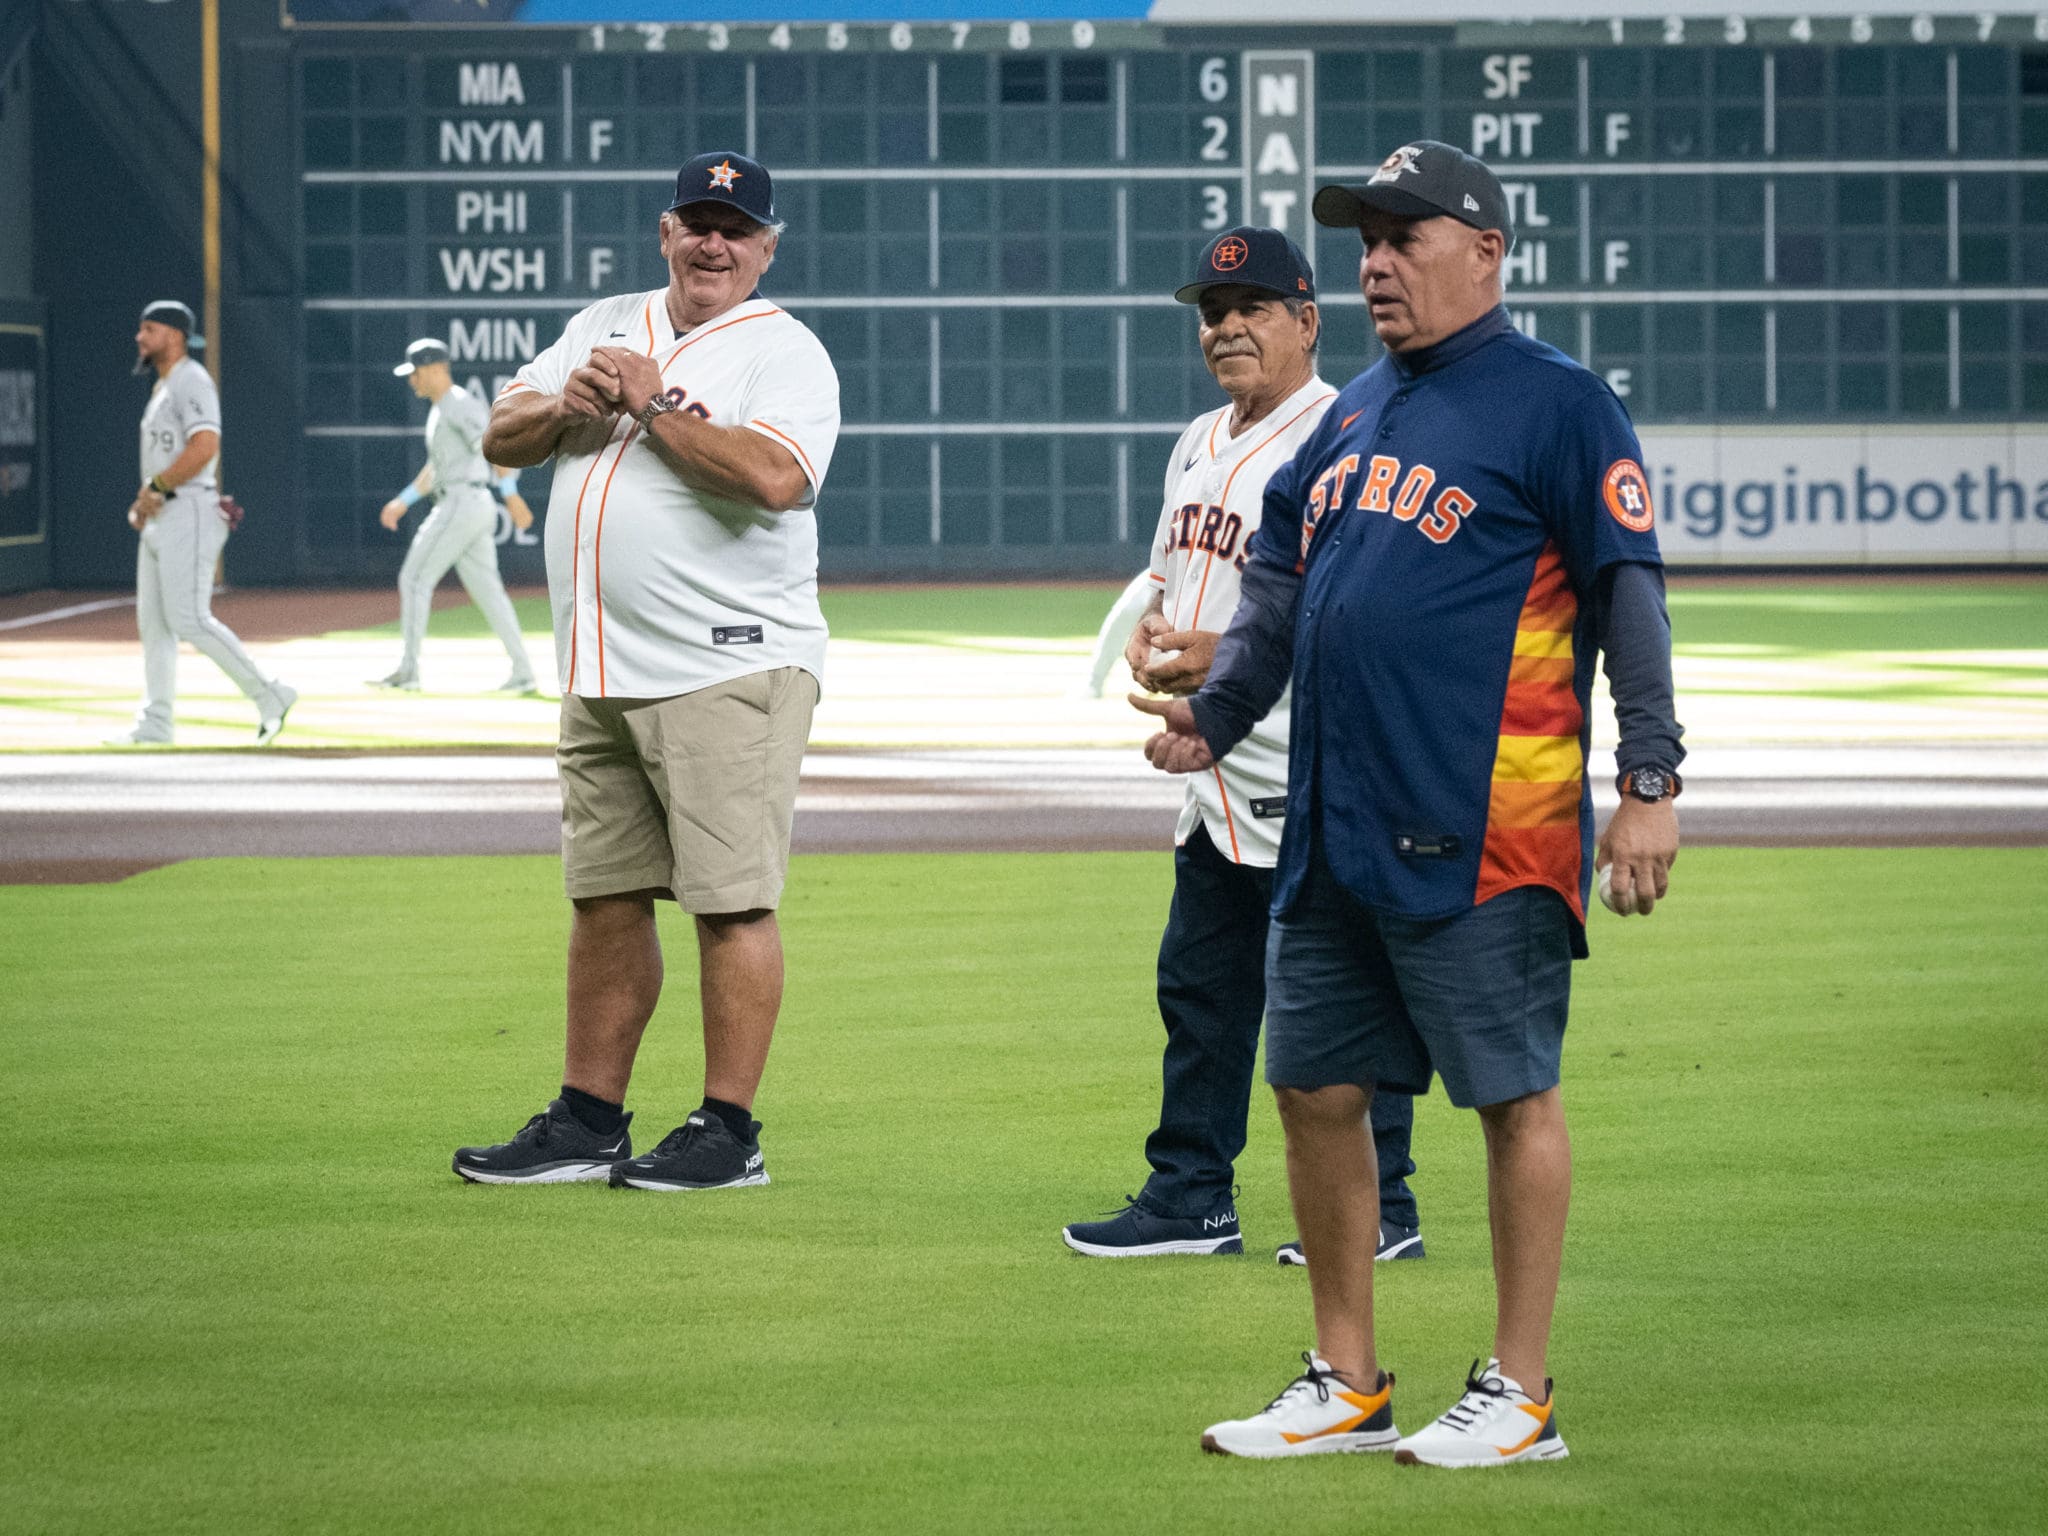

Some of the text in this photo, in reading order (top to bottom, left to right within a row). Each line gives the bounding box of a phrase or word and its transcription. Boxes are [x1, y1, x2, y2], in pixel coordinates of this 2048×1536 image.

[591, 21, 1096, 51] 1 2 3 4 5 6 7 8 9
[1608, 15, 1624, 43] 1
[1664, 15, 1685, 43] 2
[1725, 15, 1747, 43] 3
[1789, 14, 1813, 43] 4
[1851, 14, 1873, 43] 5
[1911, 13, 1935, 42] 6
[1976, 13, 1997, 42] 7
[459, 62, 525, 105] MIA
[1200, 57, 1228, 102] 6
[1482, 55, 1532, 100] SF
[439, 119, 613, 163] NYM F
[1201, 115, 1229, 161] 2
[1471, 112, 1630, 157] PIT F
[456, 190, 528, 233] PHI
[1201, 184, 1229, 230] 3
[1500, 182, 1550, 227] TL
[440, 247, 613, 292] WSH F
[1503, 240, 1631, 285] HI F
[449, 318, 537, 362] MIN
[1299, 454, 1478, 559] STROS
[1645, 465, 2048, 539] igginboth
[1165, 503, 1257, 574] STROS
[1203, 1208, 1238, 1231] NAU
